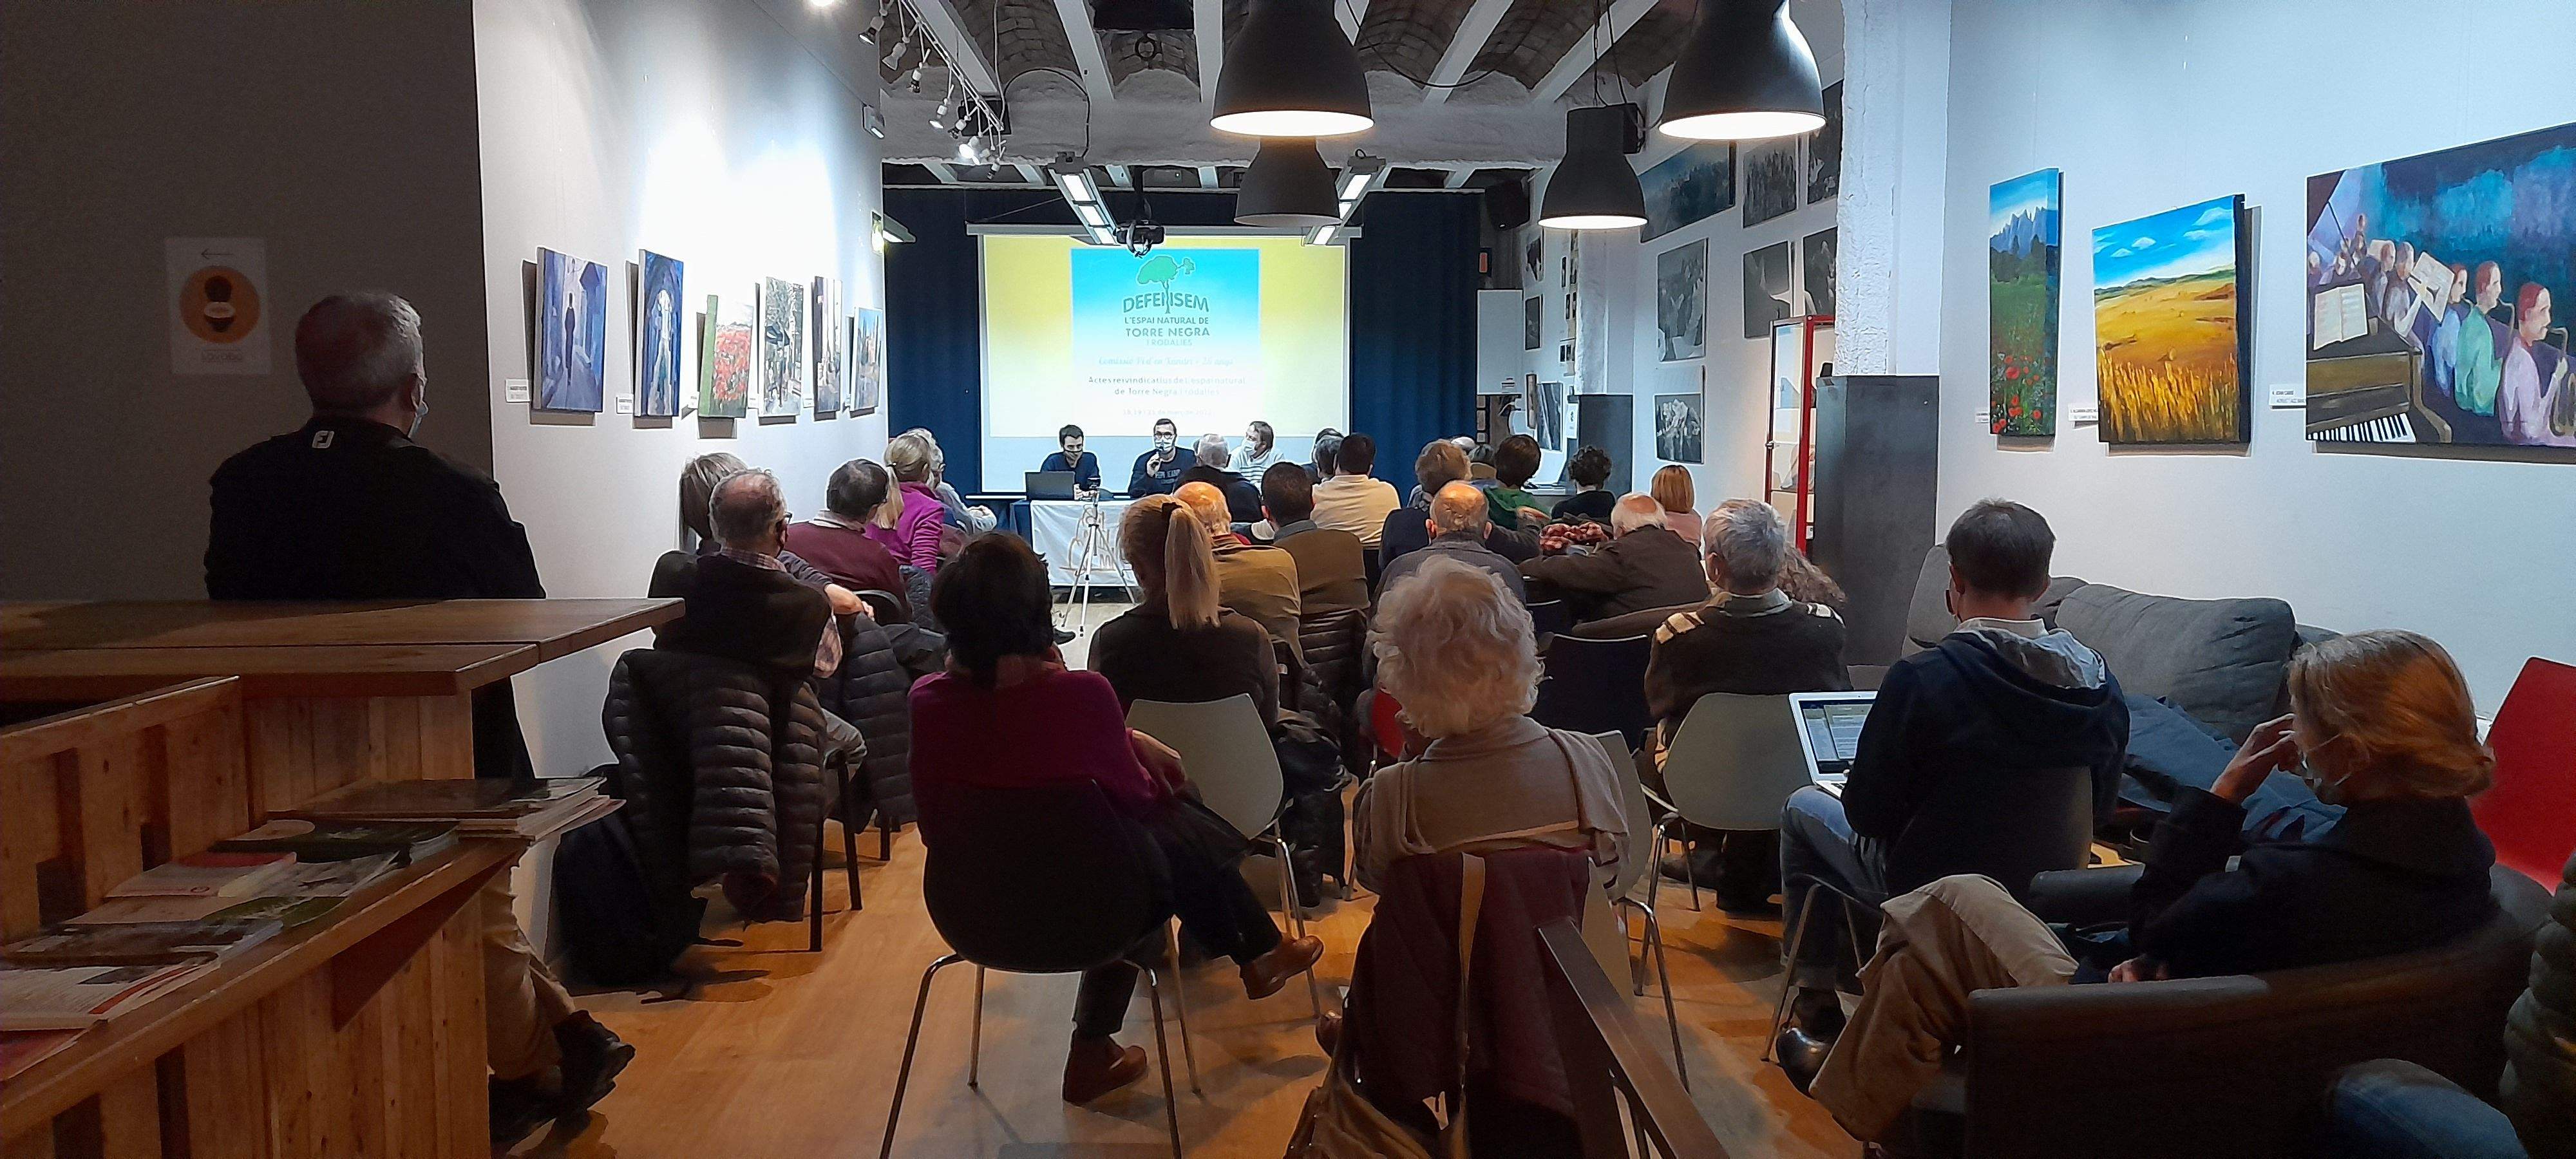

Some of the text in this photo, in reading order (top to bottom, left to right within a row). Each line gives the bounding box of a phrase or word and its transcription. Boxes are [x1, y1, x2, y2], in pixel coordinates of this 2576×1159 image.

[1123, 292, 1209, 314] DEFENSEM
[1126, 327, 1210, 337] TORRE NEGRA
